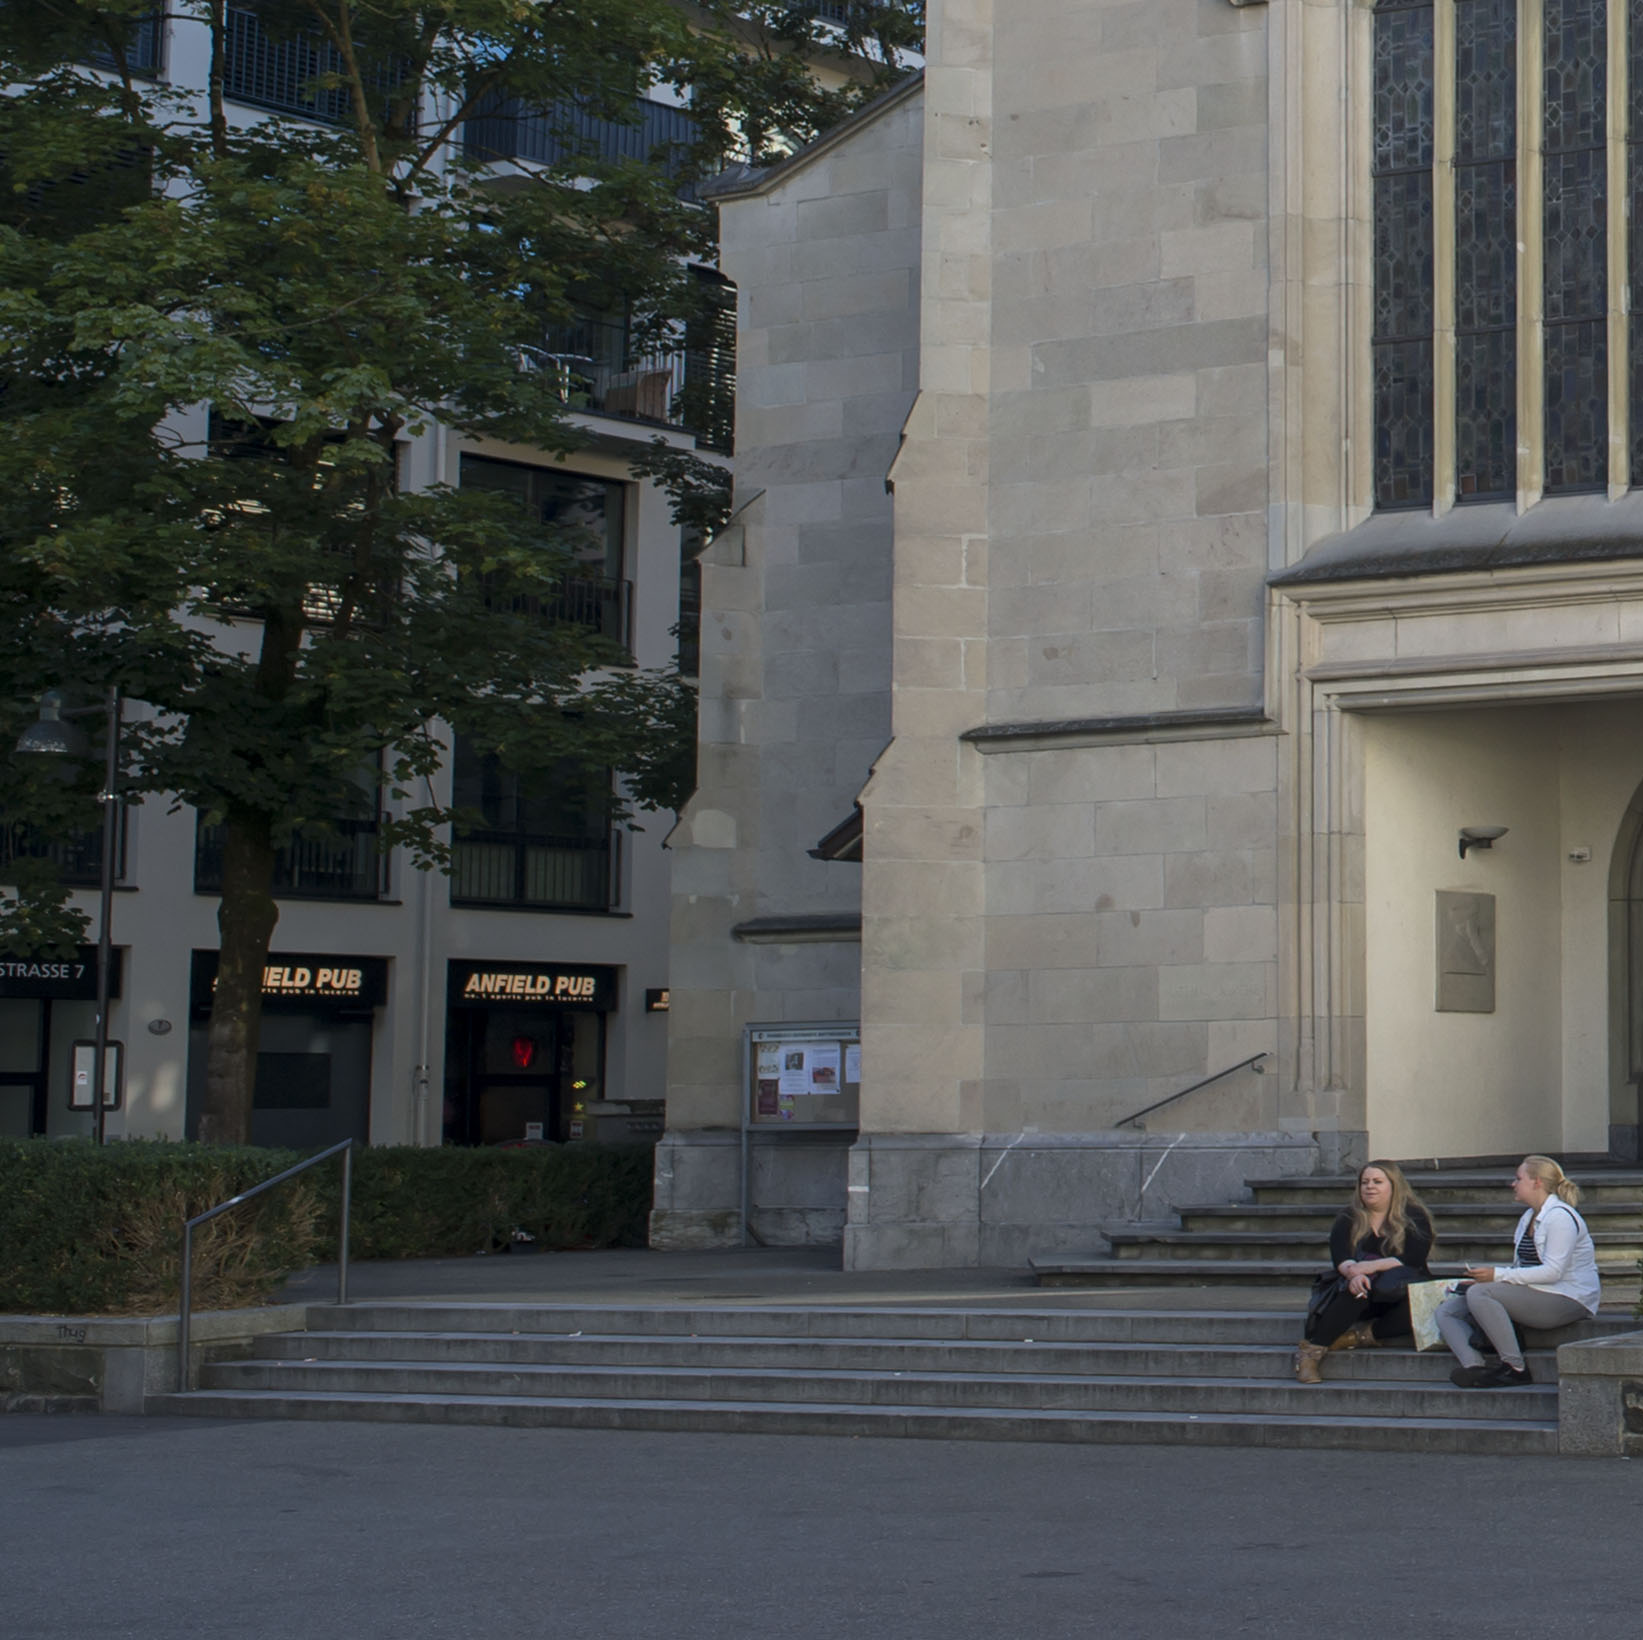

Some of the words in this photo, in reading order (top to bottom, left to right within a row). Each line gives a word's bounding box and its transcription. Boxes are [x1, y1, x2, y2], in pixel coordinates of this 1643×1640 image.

[74, 964, 85, 979] 7
[316, 968, 362, 989] PUB
[464, 973, 551, 994] ANFIELD
[555, 976, 596, 996] PUB
